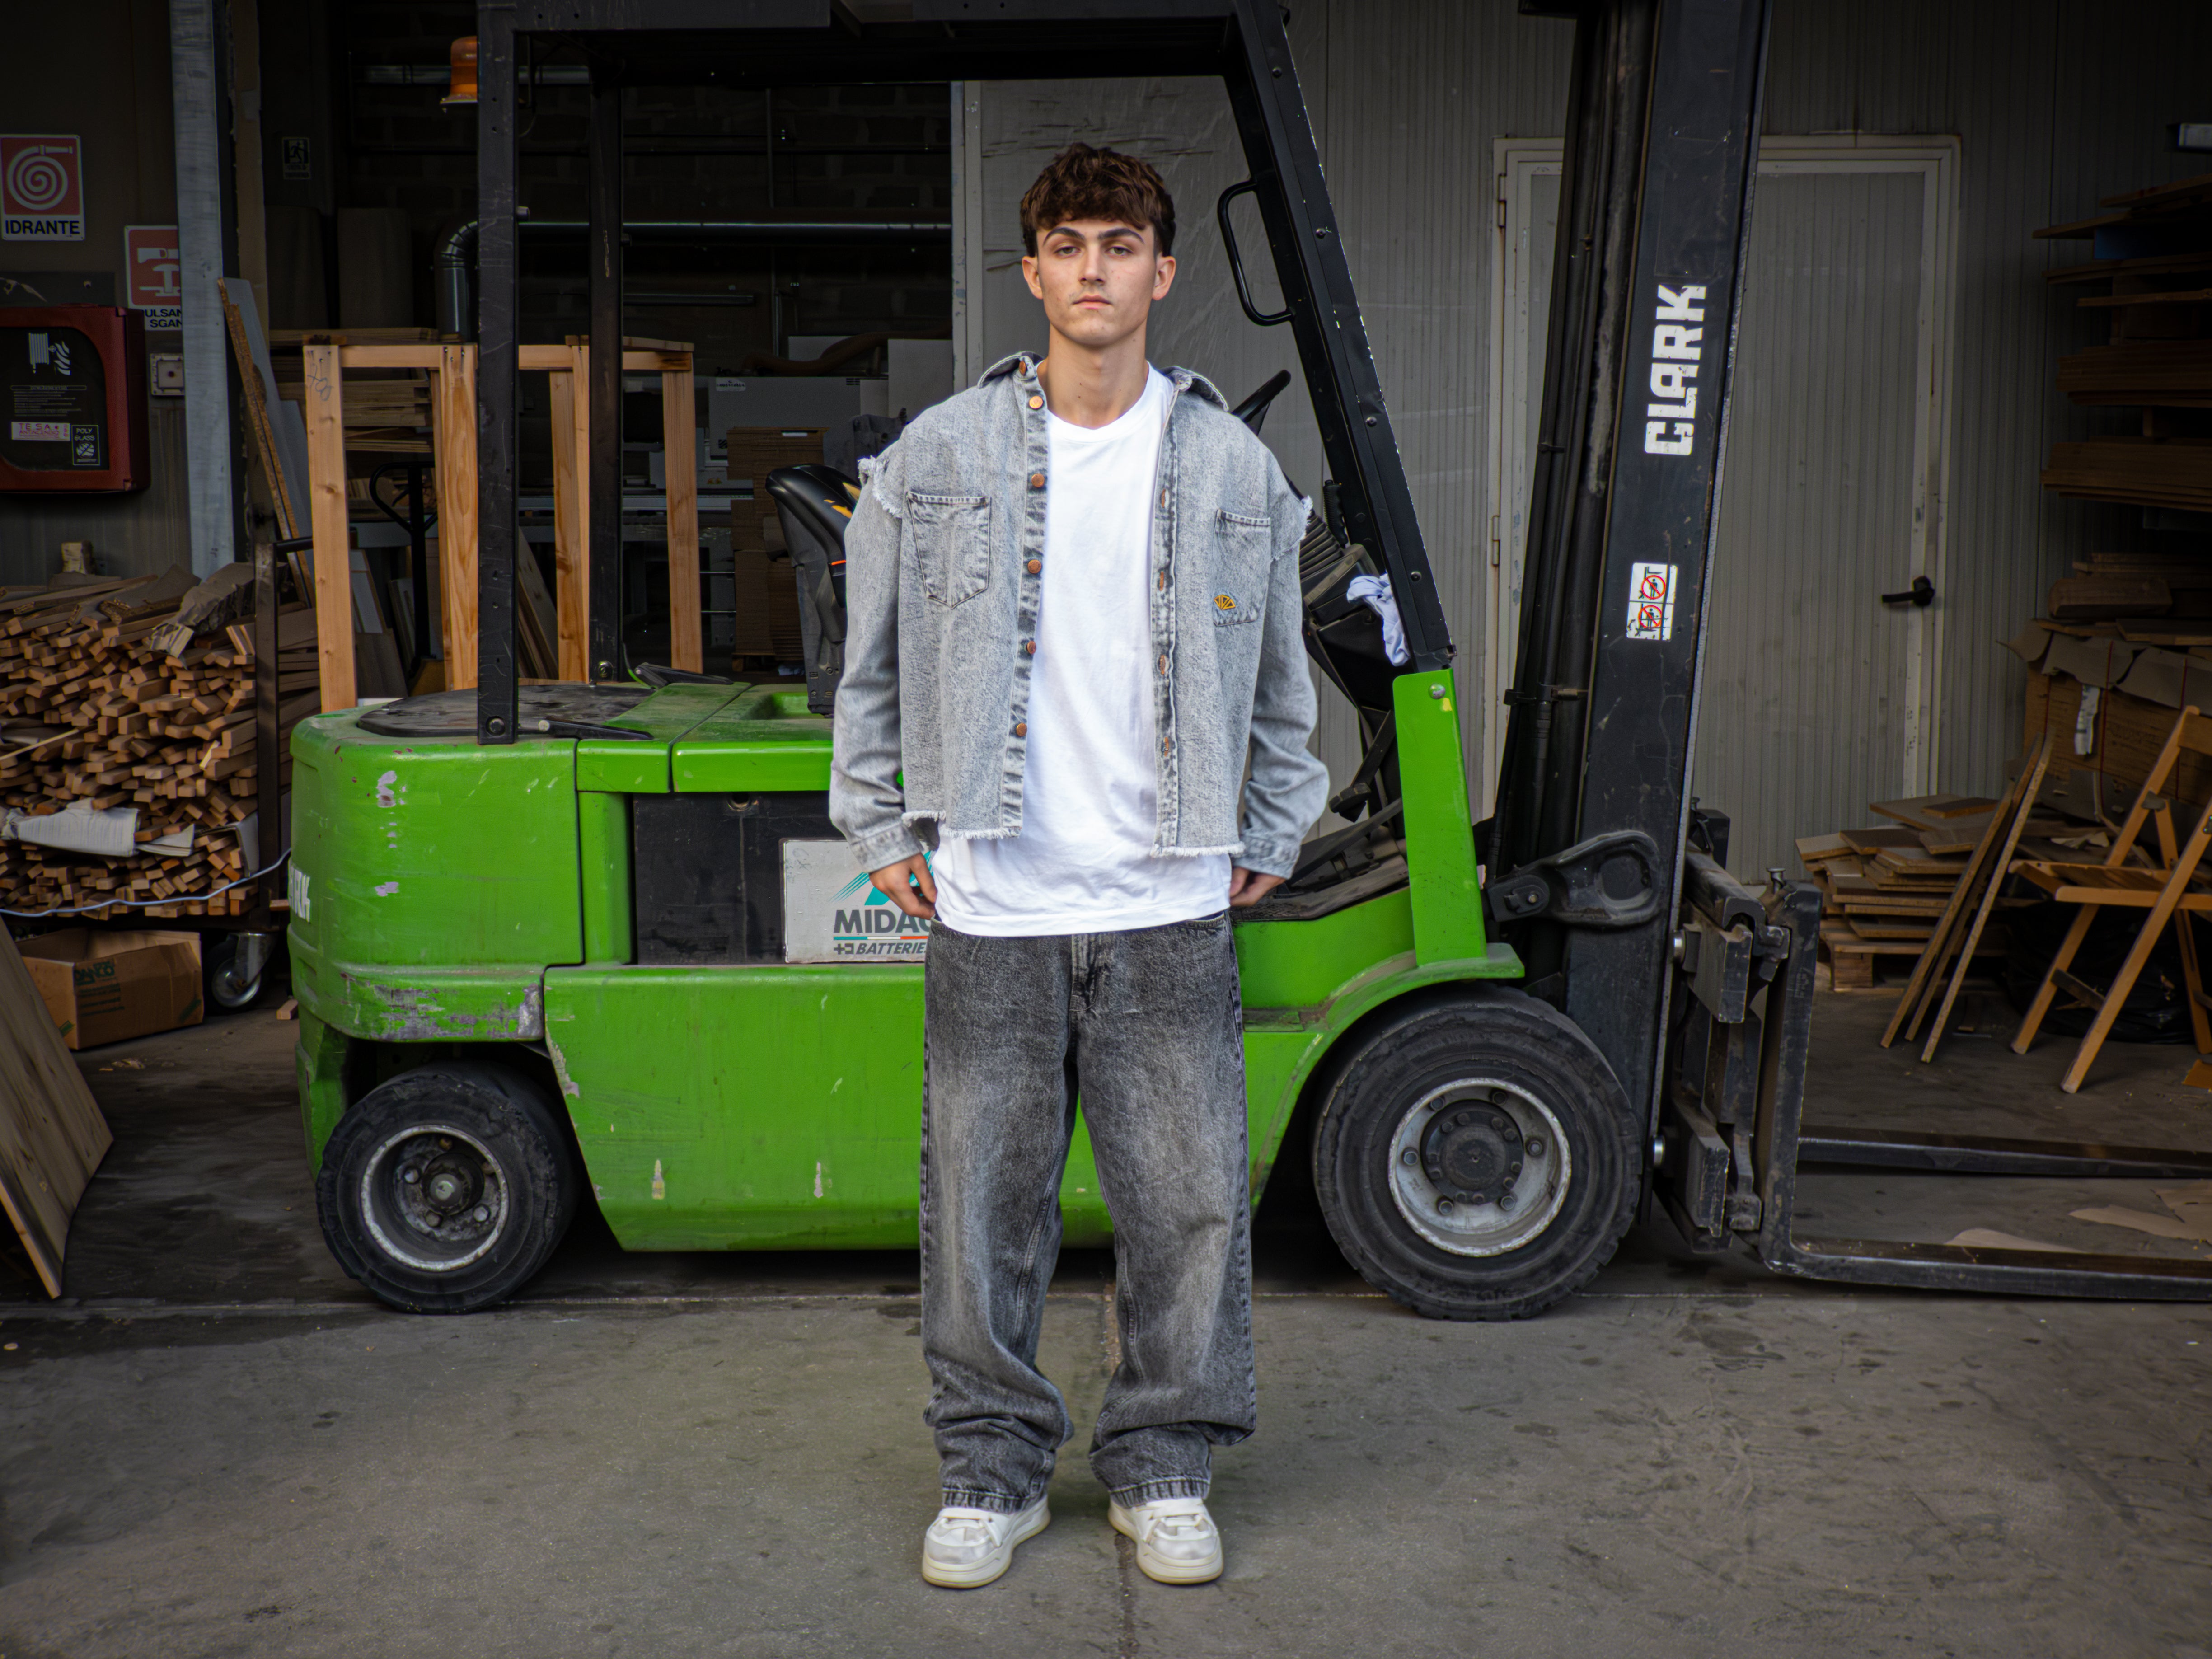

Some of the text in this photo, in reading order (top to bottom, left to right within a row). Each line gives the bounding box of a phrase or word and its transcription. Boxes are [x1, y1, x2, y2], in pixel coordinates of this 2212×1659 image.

[5, 220, 80, 234] IDRANTE
[144, 309, 182, 317] ULSAN
[1645, 284, 1707, 455] CLARK
[856, 942, 926, 955] BATTERIE
